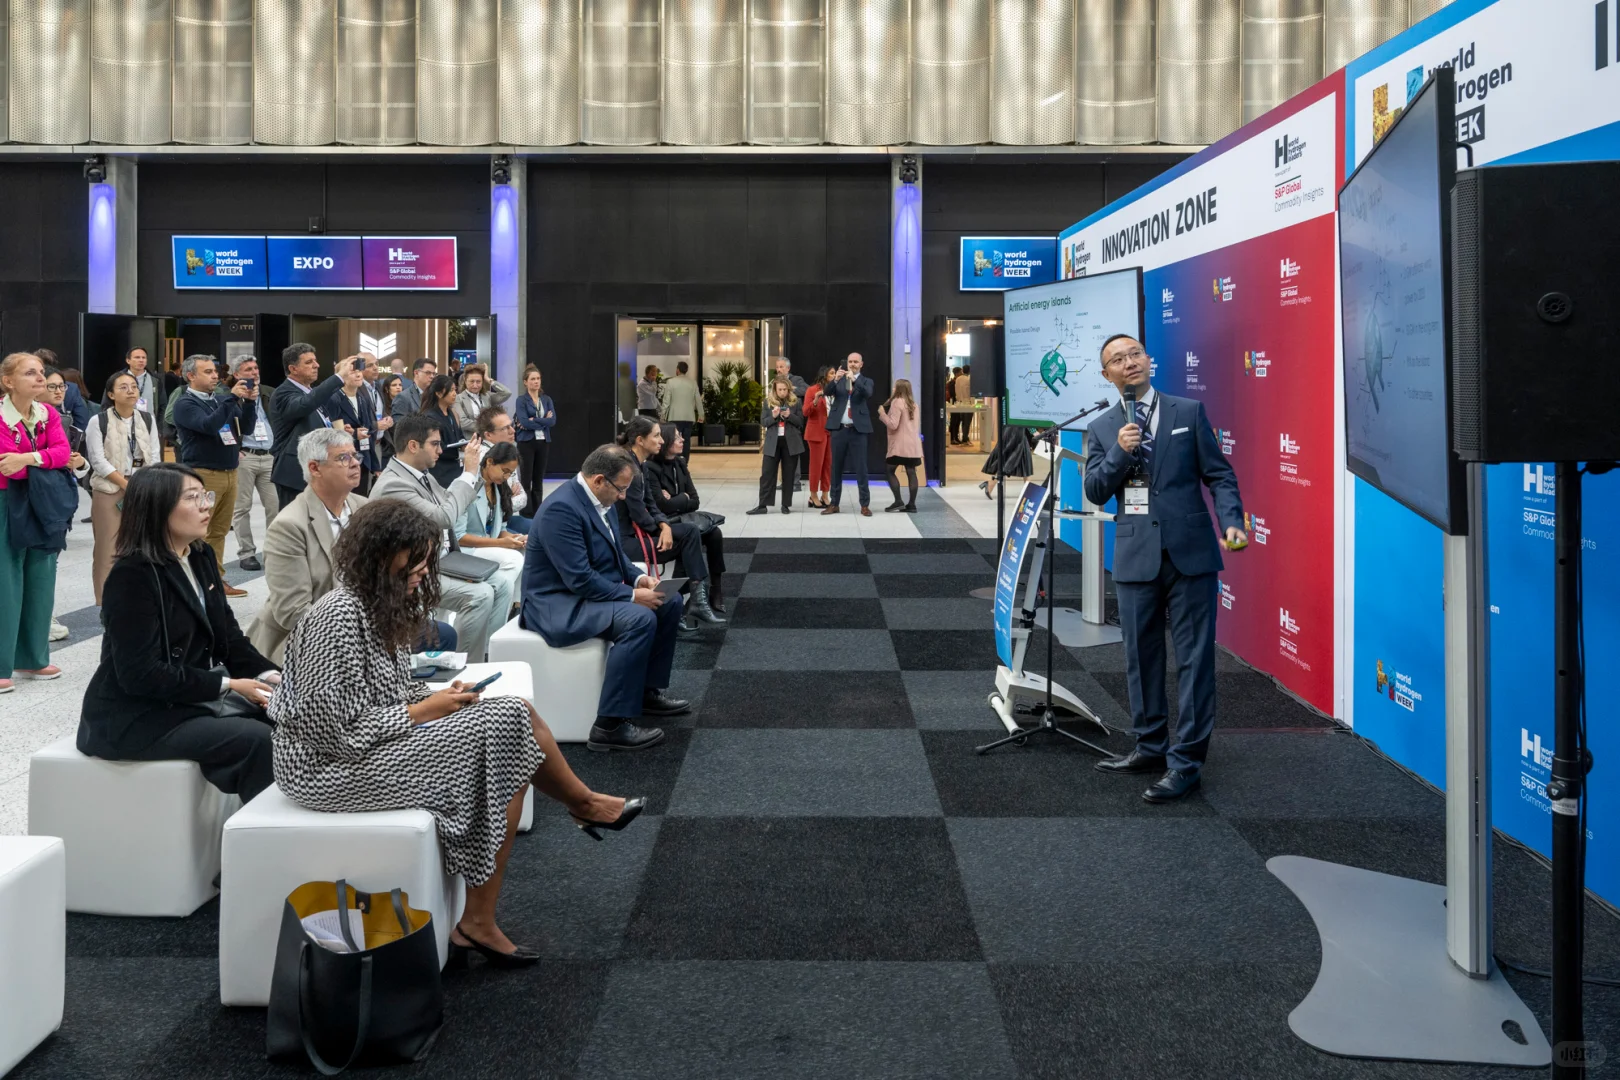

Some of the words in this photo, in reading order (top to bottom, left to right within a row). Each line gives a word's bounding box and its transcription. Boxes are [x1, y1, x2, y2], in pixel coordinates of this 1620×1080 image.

[1454, 62, 1512, 104] rogen
[1275, 186, 1285, 199] S&P
[1286, 180, 1301, 195] Global
[1275, 196, 1302, 212] Commodity
[1303, 187, 1324, 202] Insights
[1102, 208, 1170, 264] INNOVATION
[1176, 186, 1217, 236] ZONE
[216, 258, 253, 266] hydrogen
[293, 256, 334, 269] EXPO
[1004, 259, 1042, 267] hydrogen
[1009, 301, 1030, 312] Artificial
[1030, 300, 1050, 310] energy
[1051, 295, 1071, 307] islands
[1524, 512, 1539, 523] S&P
[1523, 524, 1555, 540] Commod
[1396, 671, 1411, 685] world
[1396, 680, 1422, 701] hydrogen
[1397, 693, 1413, 709] WEEK
[1521, 776, 1536, 791] S&P
[1520, 788, 1552, 815] Commod
